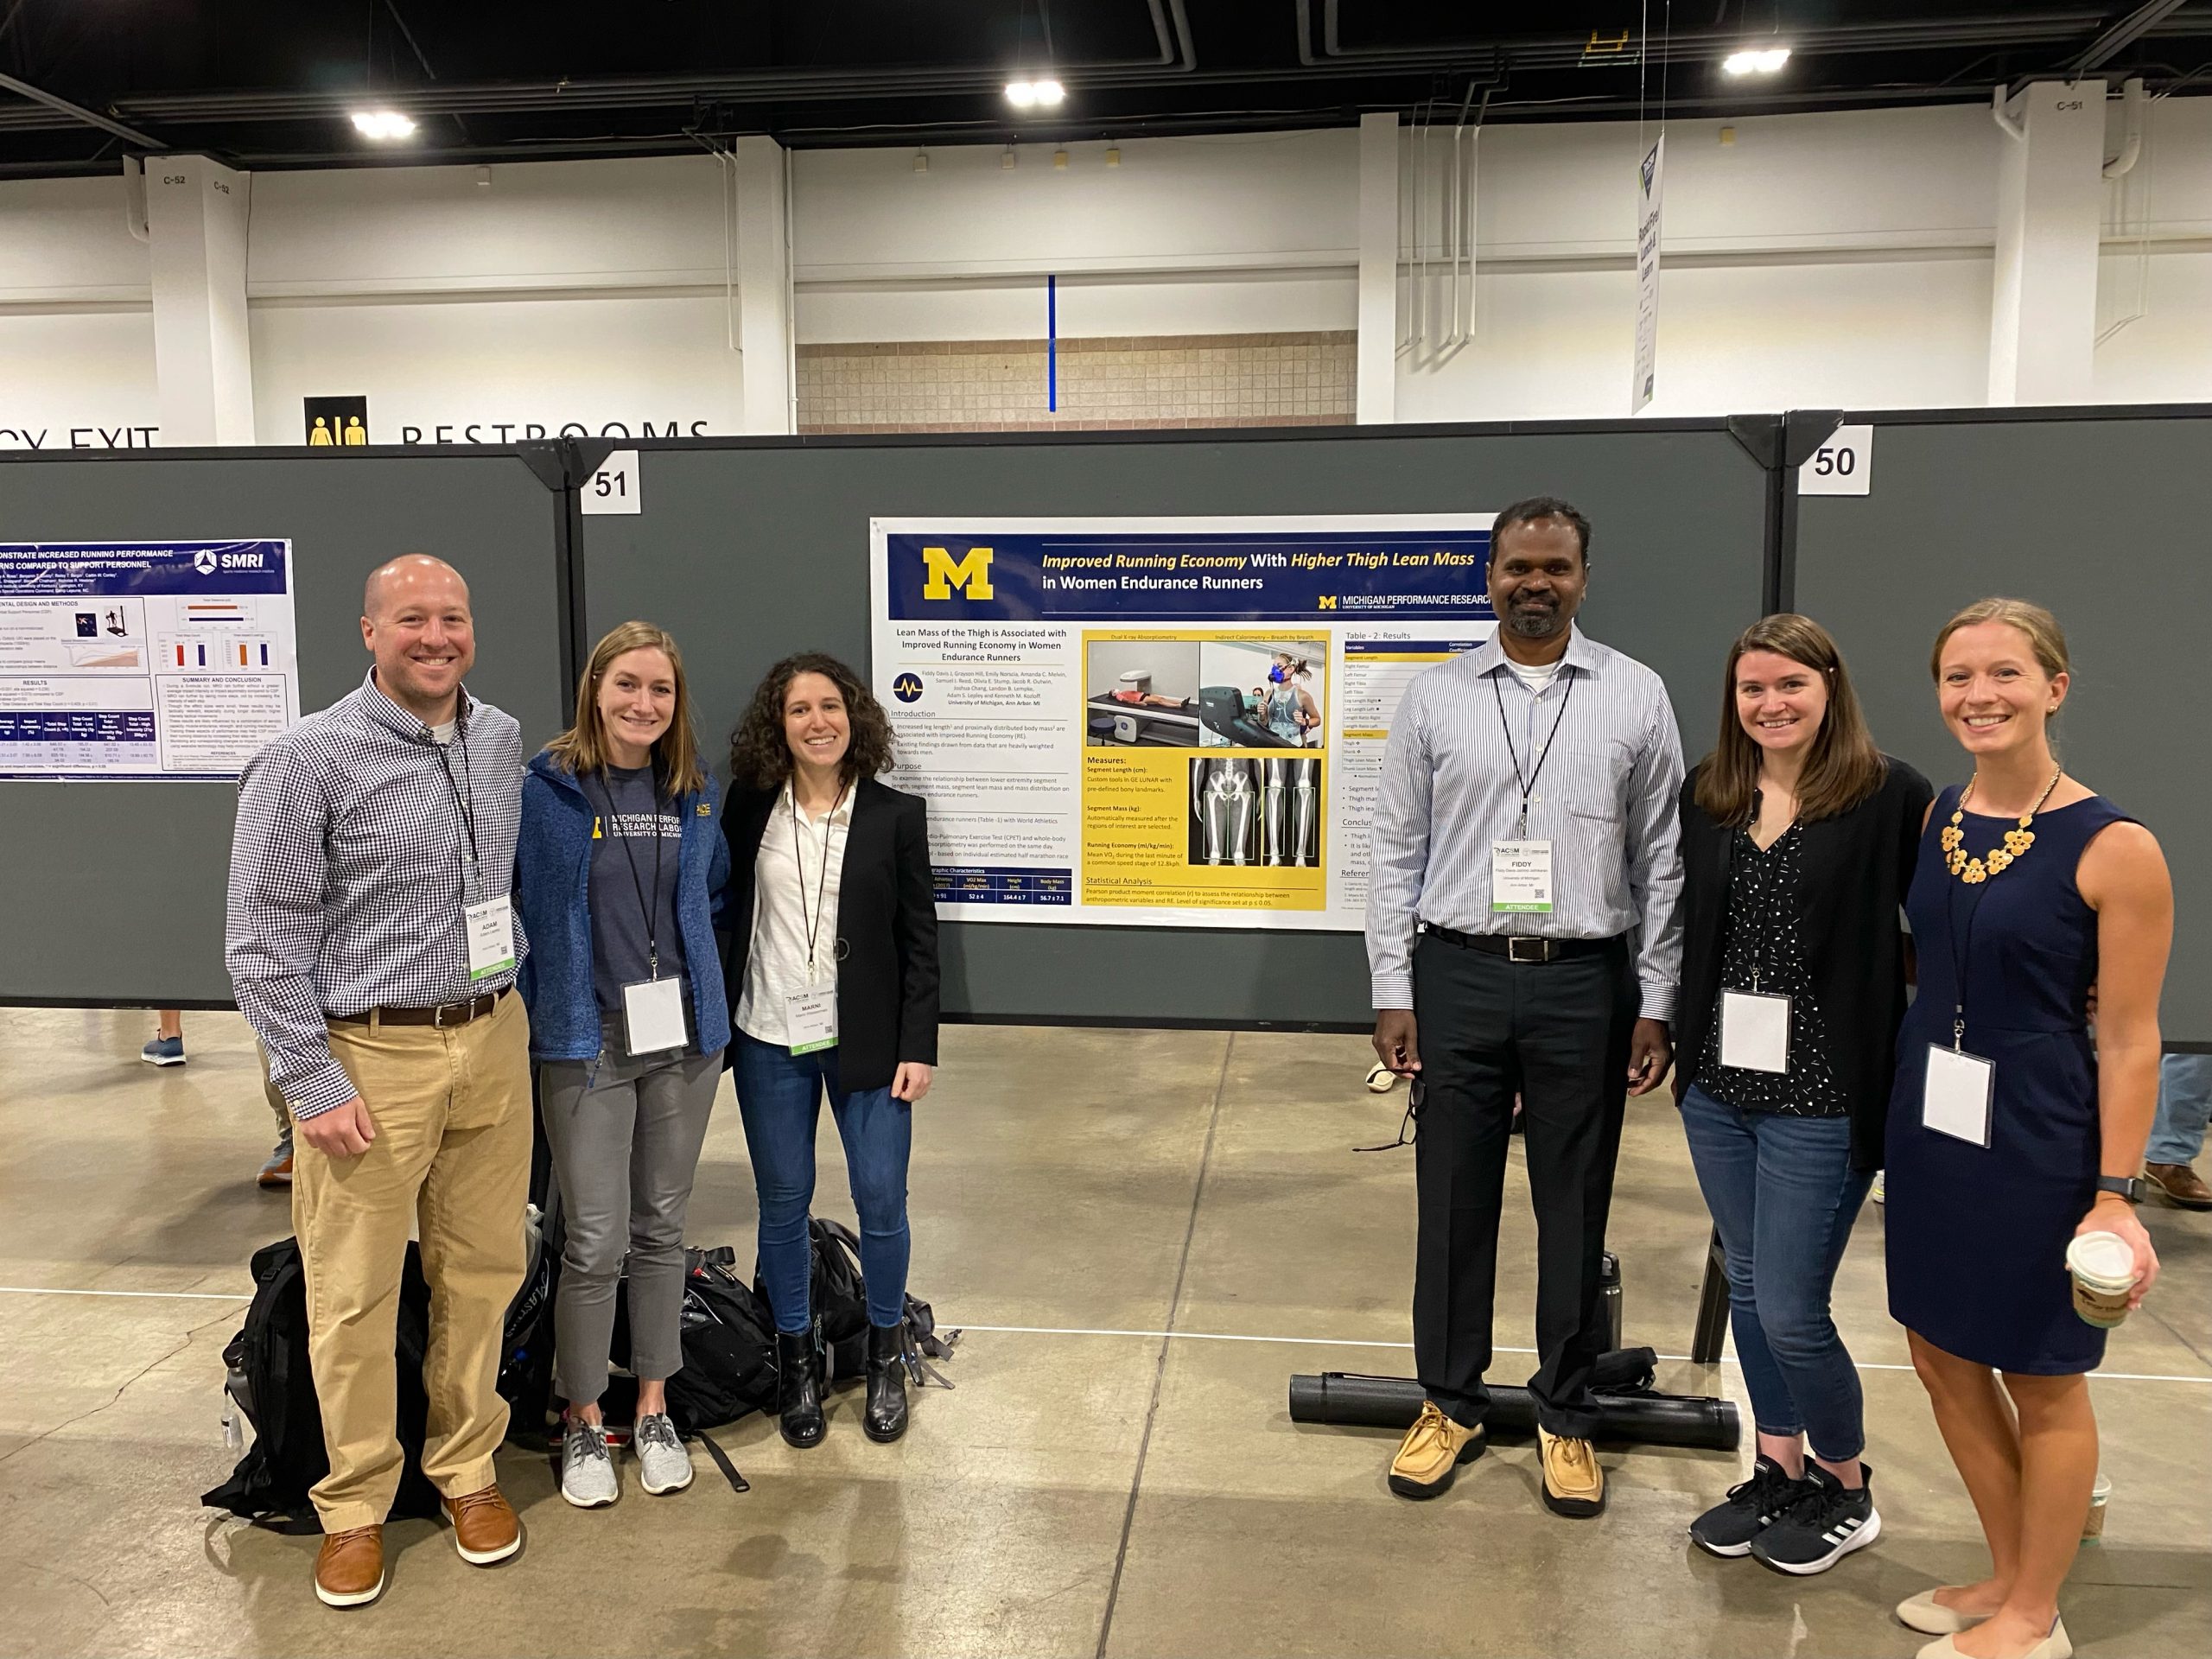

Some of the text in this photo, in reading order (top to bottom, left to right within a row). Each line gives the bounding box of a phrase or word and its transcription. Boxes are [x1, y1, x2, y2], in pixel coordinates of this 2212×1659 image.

[2057, 101, 2082, 111] C-51
[214, 181, 229, 194] C-52
[1815, 446, 1855, 475] 50
[594, 469, 626, 497] 51
[59, 562, 68, 570] TO
[71, 561, 105, 570] SUPPORT
[106, 561, 150, 569] PERSONNEL
[221, 554, 264, 568] SMRI
[1042, 552, 1474, 570] Improved Running Economy With Higher Thigh Lean Mass
[923, 548, 993, 600] M
[1042, 575, 1263, 589] in Women Endurance Runners
[1319, 596, 1337, 609] M
[1343, 595, 1385, 605] MICHIGAN
[1387, 595, 1449, 604] PERFORMANCE
[968, 629, 989, 638] Thigh
[1346, 631, 1366, 641] Table
[1374, 631, 1381, 641] 2:
[1383, 631, 1410, 641] Results
[902, 641, 941, 650] Improved
[944, 641, 976, 650] Running
[980, 642, 1016, 651] Economy
[892, 709, 935, 719] Introduction
[893, 761, 921, 772] Purpose
[1086, 877, 1152, 887] Statistical Analysis
[482, 921, 497, 931] ADAM
